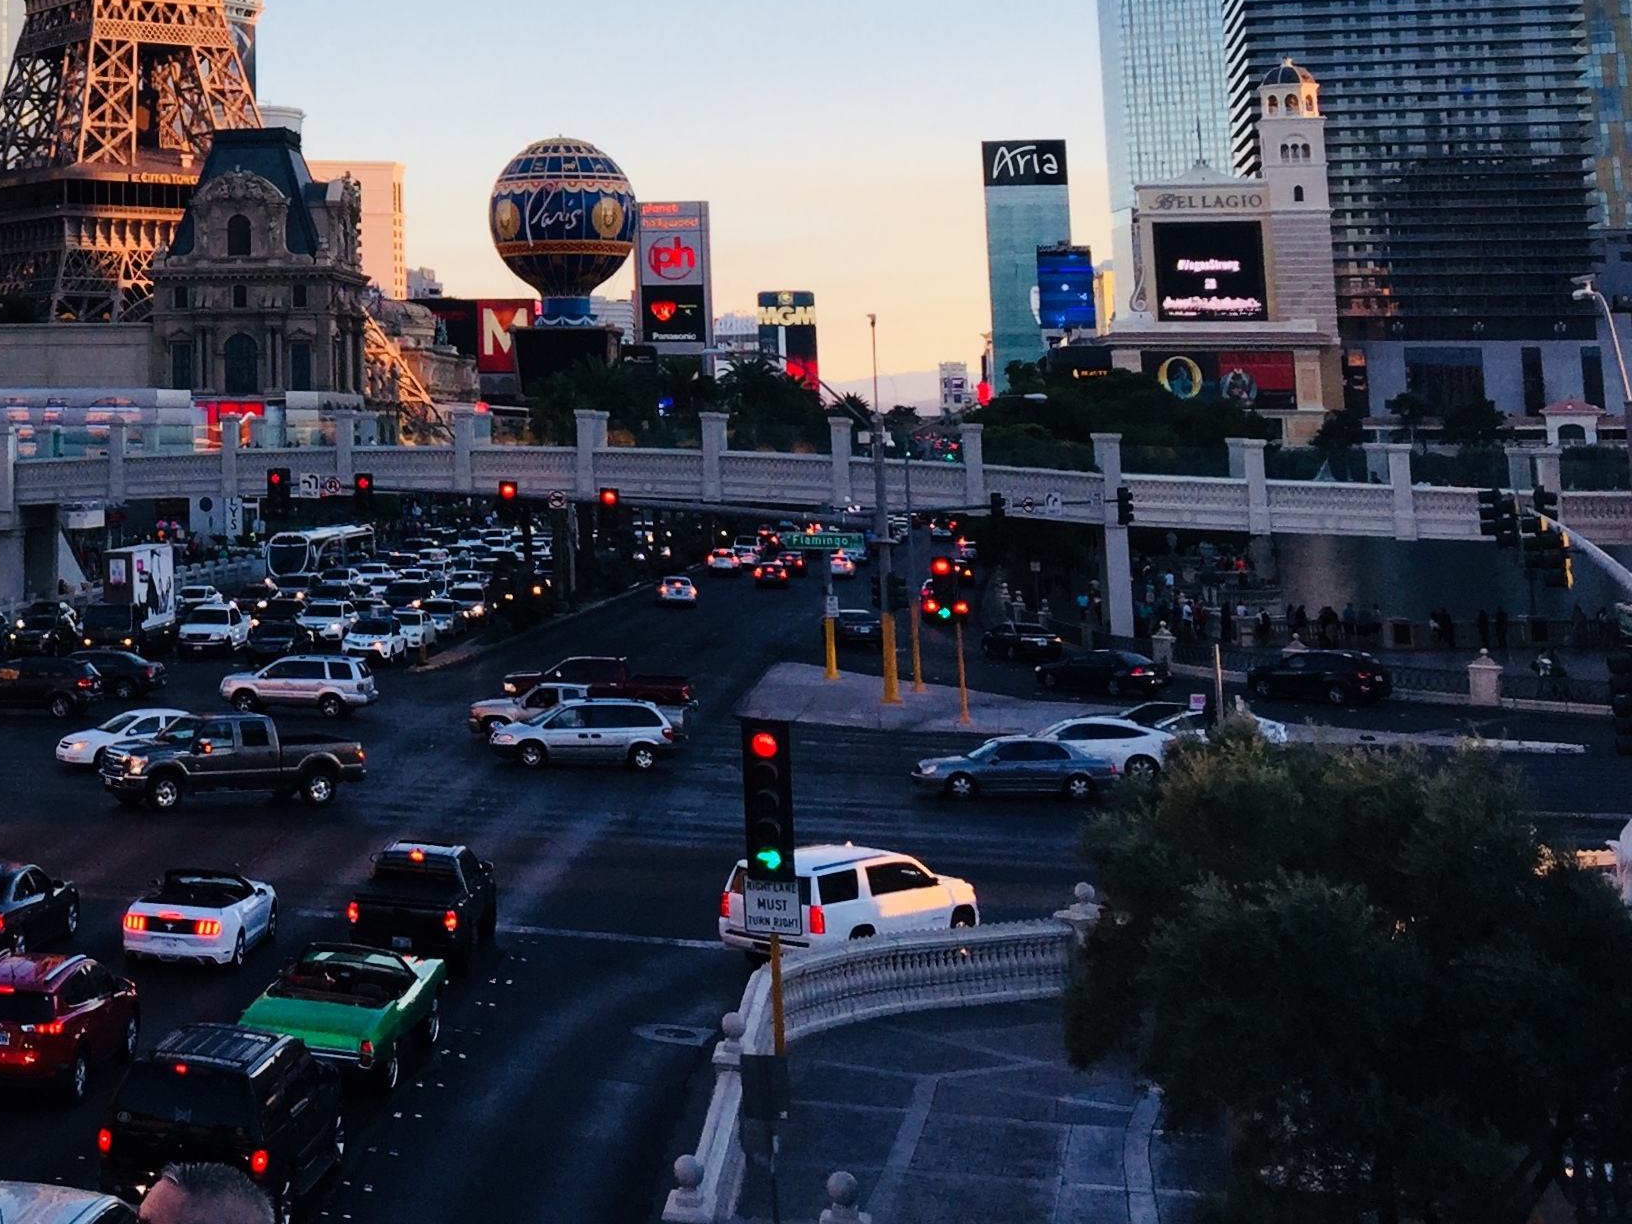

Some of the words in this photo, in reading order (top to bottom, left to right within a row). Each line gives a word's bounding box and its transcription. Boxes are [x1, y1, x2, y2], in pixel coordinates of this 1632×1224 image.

[992, 145, 1058, 179] Aria
[641, 203, 680, 214] planet
[1149, 193, 1263, 210] BELLAGIO
[526, 180, 582, 247] Paris
[642, 217, 699, 228] hollywood
[756, 306, 817, 326] MGM
[652, 332, 696, 341] Panasonic
[792, 536, 849, 548] Flamingo
[757, 897, 788, 912] MUST
[748, 915, 771, 926] TURN
[773, 916, 798, 928] RIGHT
